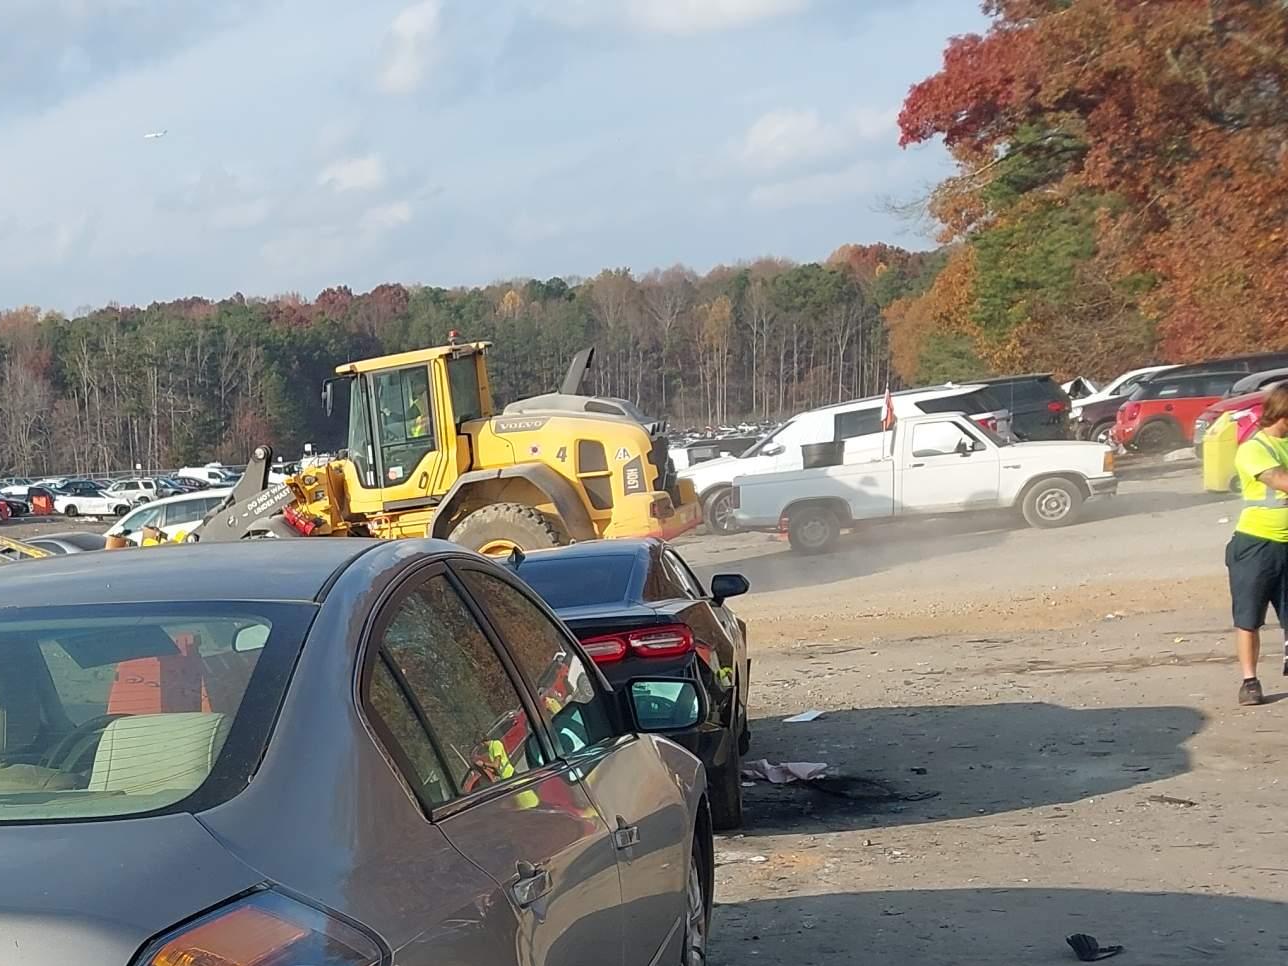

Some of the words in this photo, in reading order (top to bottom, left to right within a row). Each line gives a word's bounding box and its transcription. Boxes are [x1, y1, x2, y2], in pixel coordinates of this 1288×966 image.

[499, 420, 543, 431] VOLVO
[556, 446, 568, 463] 4
[247, 500, 257, 511] DO
[257, 491, 272, 504] NOT
[270, 482, 287, 494] WAL
[254, 499, 275, 515] UNDER
[274, 489, 290, 502] MAST
